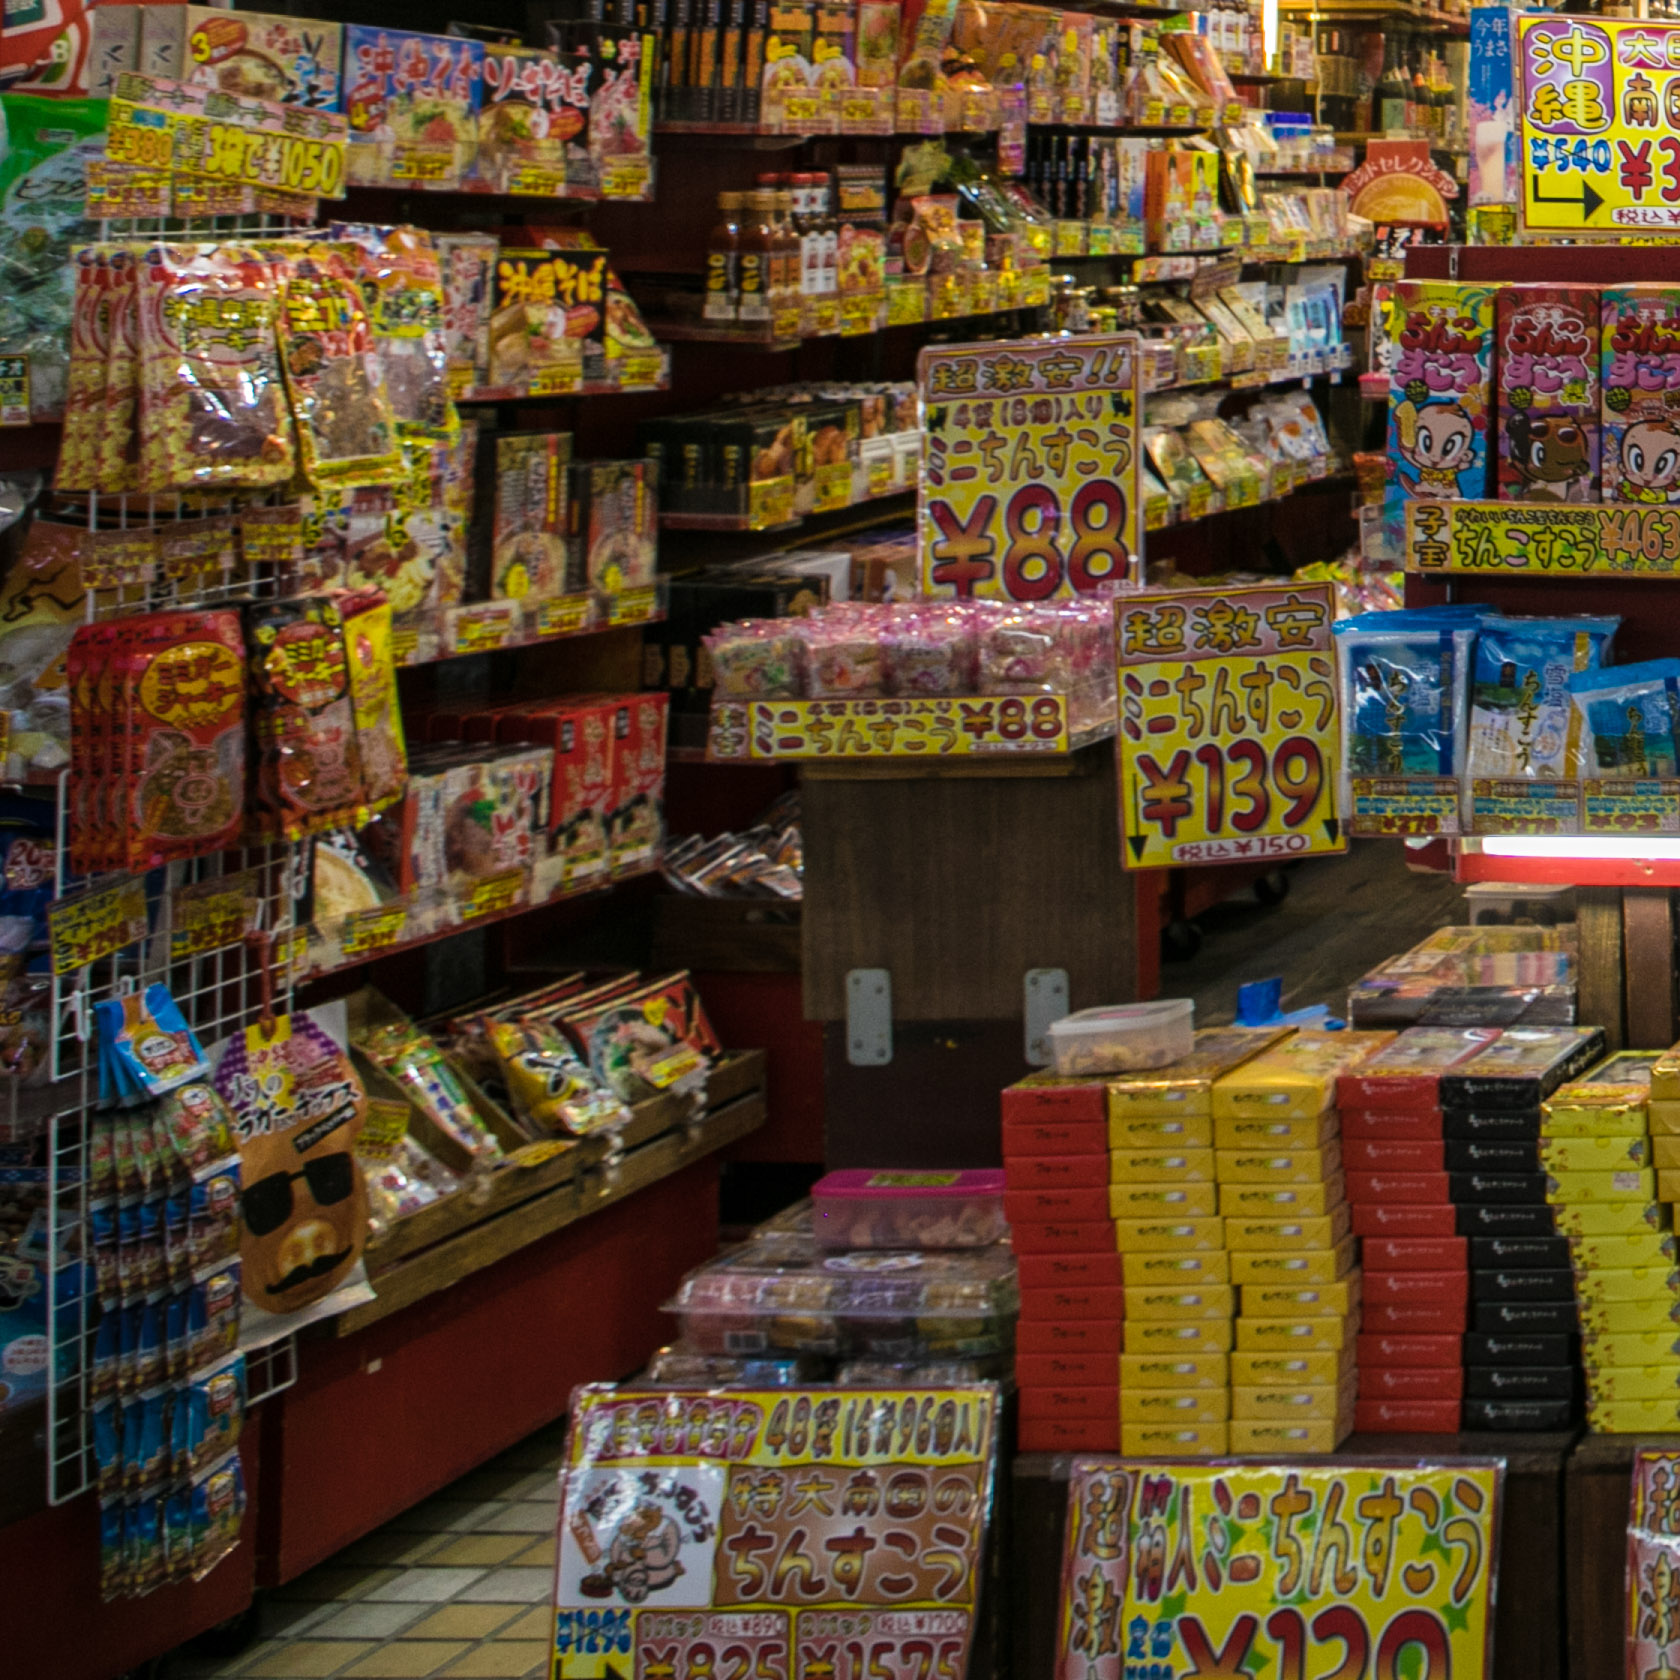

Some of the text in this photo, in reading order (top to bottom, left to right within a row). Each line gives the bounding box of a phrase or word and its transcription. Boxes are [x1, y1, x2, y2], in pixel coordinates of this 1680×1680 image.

[1529, 28, 1609, 131] 沖縄
[930, 348, 1125, 395] 超激安!!
[928, 424, 1133, 487] ミニちんすこう
[930, 477, 1129, 600] ¥88
[1122, 595, 1325, 657] 超激安
[959, 697, 1065, 740] ¥88
[1124, 657, 1335, 742] ミニちんすこう
[805, 718, 958, 753] ちんすこう
[1135, 736, 1324, 838] ¥139
[727, 1525, 969, 1599] ちんすこう
